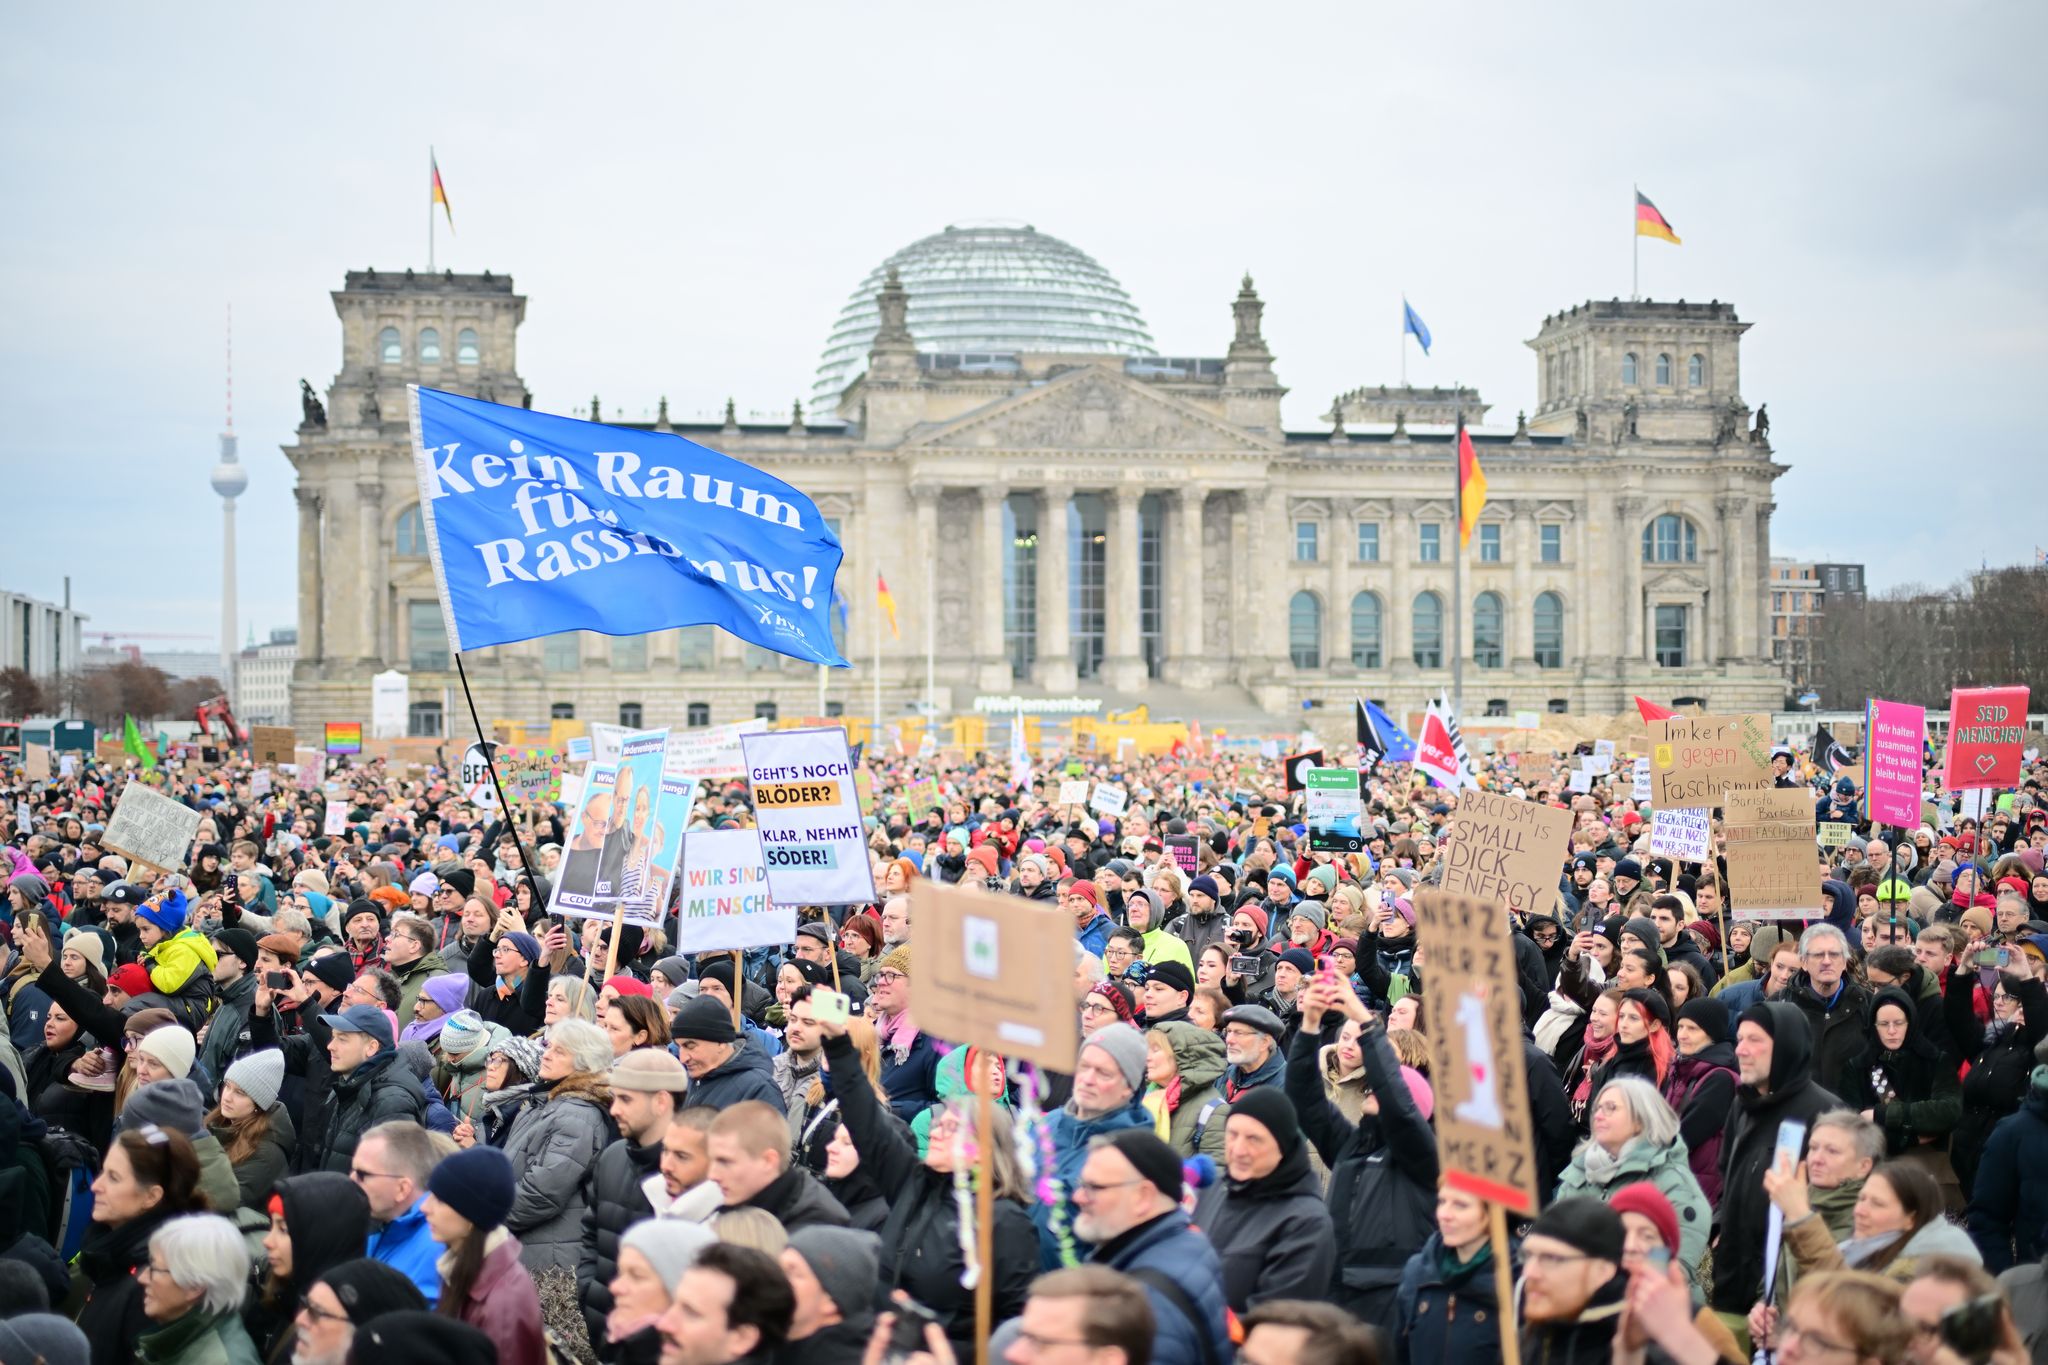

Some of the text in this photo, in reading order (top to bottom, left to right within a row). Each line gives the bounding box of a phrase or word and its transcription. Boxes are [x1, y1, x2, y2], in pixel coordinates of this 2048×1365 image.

[424, 439, 805, 531] Kein Raum
[973, 695, 1102, 712] #WeRemember
[1975, 705, 2009, 722] SEID
[1665, 720, 1725, 741] Imker
[1877, 723, 1915, 738] Wir halten
[1956, 726, 2024, 745] MENSCHEN
[1876, 740, 1917, 754] zusammen.
[509, 757, 549, 772] Die Welt
[1422, 743, 1457, 771] ver.di
[1682, 746, 1736, 768] gegen
[1900, 758, 1917, 769] Welt
[521, 772, 552, 789] bunt!
[596, 773, 615, 785] Wie
[752, 766, 799, 781] GEHT'S
[803, 763, 849, 777] NOCH
[1875, 768, 1916, 784] bleibt bunt.
[756, 784, 831, 804] BLÖDER?
[1730, 792, 1777, 808] Barista,
[1463, 792, 1536, 824] RACISM
[1756, 802, 1804, 820] Barista
[1655, 811, 1676, 825] HEGEN
[1681, 816, 1709, 830] PFLEGEN
[763, 826, 859, 844] KLAR, NEHMT
[1456, 820, 1526, 853] SMALL
[1534, 824, 1552, 840] IS
[1654, 824, 1707, 843] UND ALLE NAZIS
[1652, 839, 1663, 848] VON
[1665, 840, 1676, 850] DER
[767, 846, 828, 865] SÖDER!
[1450, 841, 1510, 877] DICK
[689, 867, 766, 887] WIR SIND
[1446, 868, 1542, 911] ENERGY
[569, 895, 592, 905] CDU
[689, 894, 794, 918] MENSCHE
